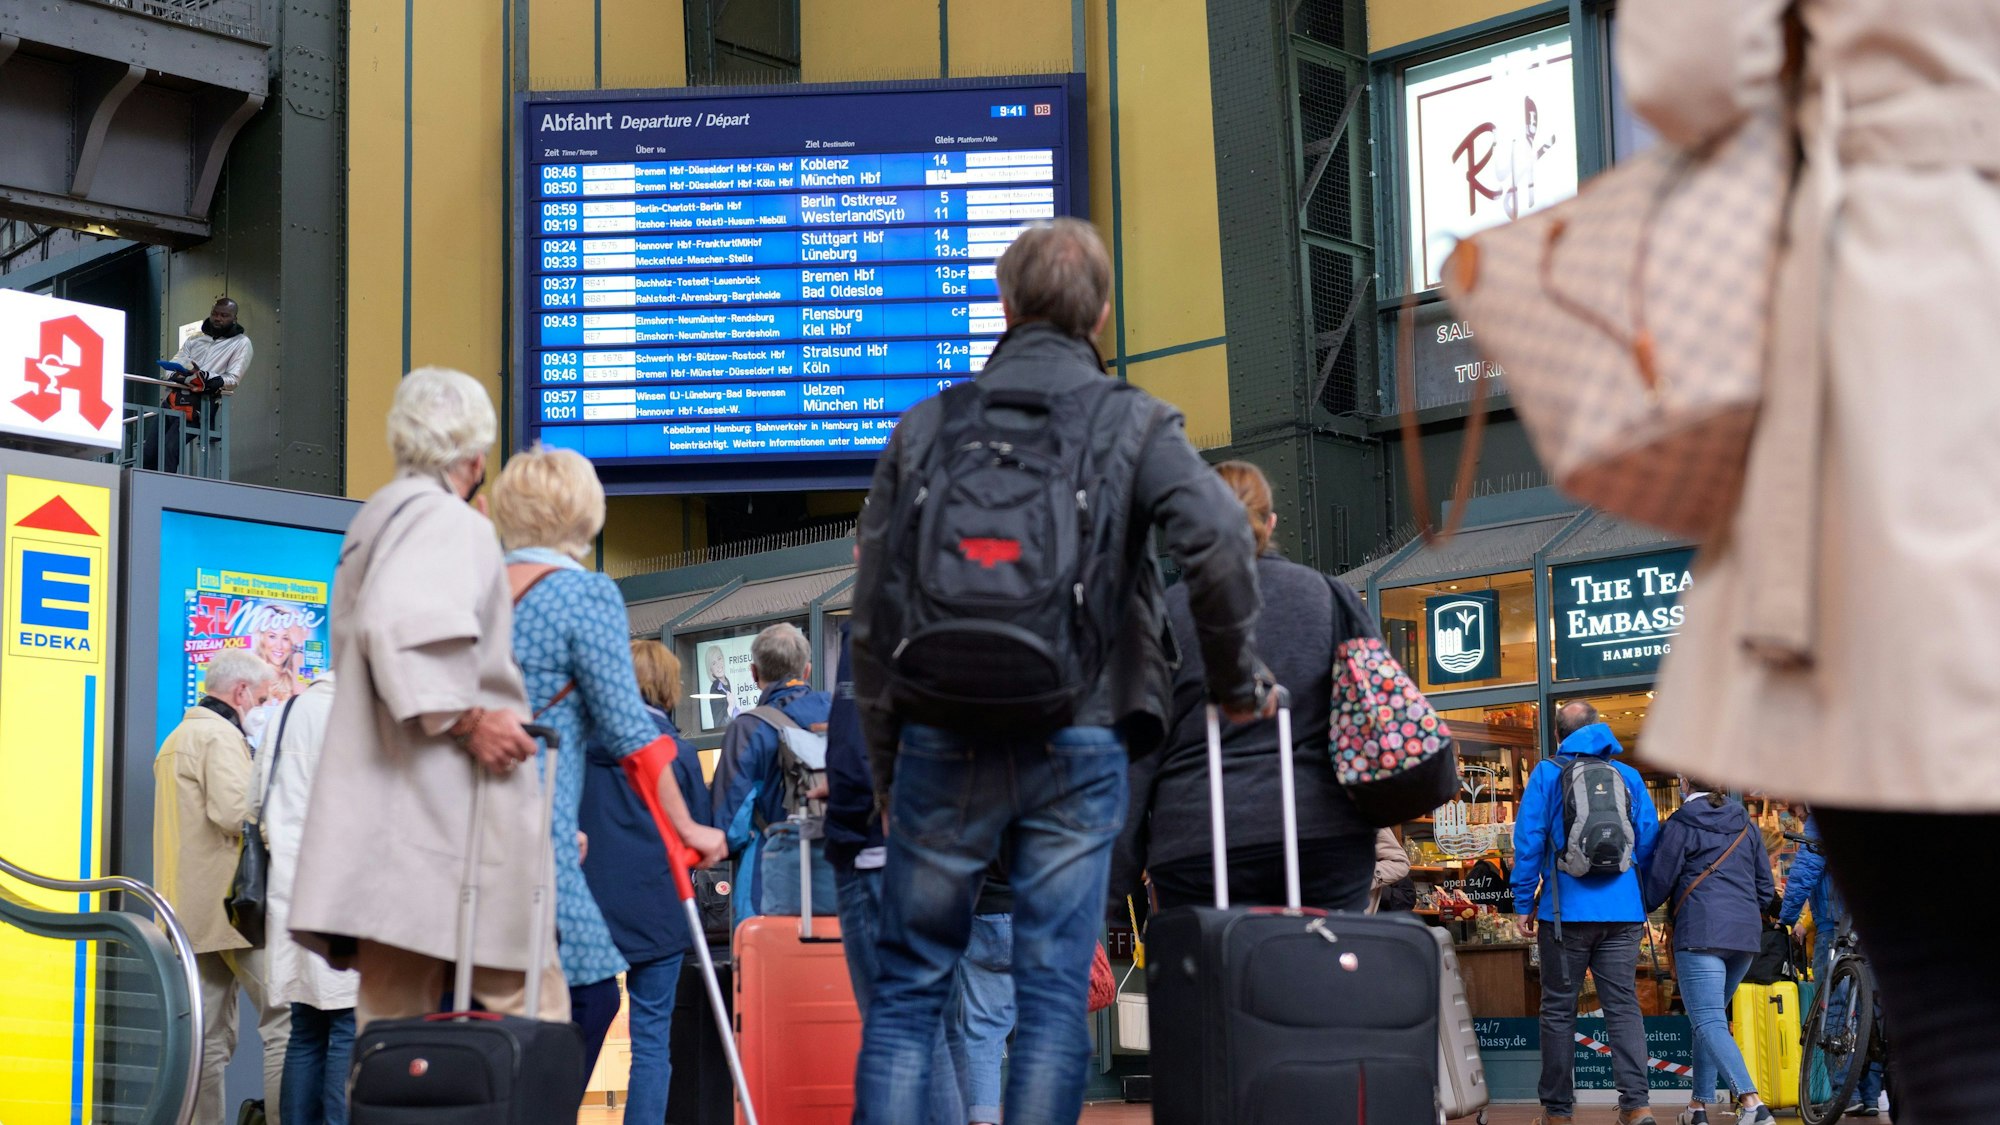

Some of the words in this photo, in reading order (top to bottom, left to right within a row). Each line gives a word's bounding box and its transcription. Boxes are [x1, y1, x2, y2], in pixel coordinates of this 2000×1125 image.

[1000, 106, 1022, 116] 9:41
[1036, 106, 1049, 114] DB
[541, 113, 613, 131] Abfahrt
[621, 115, 692, 130] Departure
[696, 114, 702, 126] /
[706, 113, 750, 128] Départ
[805, 140, 819, 148] Ziel
[935, 136, 954, 144] Gleis
[545, 148, 559, 157] Zeit
[636, 145, 654, 155] Über
[801, 158, 848, 171] Koblenz
[934, 154, 948, 166] 14
[544, 166, 576, 179] 08:46
[636, 166, 666, 176] Bremen
[737, 162, 775, 173] Hbf-Köln
[779, 162, 793, 171] Hbf
[935, 170, 948, 181] 14
[636, 182, 666, 191] Bremen
[737, 177, 775, 188] Hbf-Köln
[779, 177, 793, 187] Hbf
[801, 172, 855, 186] München
[860, 171, 880, 184] Hbf
[544, 182, 577, 194] 08:50
[802, 195, 835, 207] Berlin
[842, 194, 897, 206] Ostkreuz
[941, 192, 948, 203] 5
[544, 204, 577, 216] 08:59
[727, 200, 741, 210] Hbf
[802, 208, 904, 223] Westerland(Sylt)
[934, 208, 948, 219] 11
[544, 219, 577, 231] 09:19
[802, 232, 857, 246] Stuttgart
[864, 231, 884, 243] Hbf
[935, 230, 949, 241] 14
[544, 240, 576, 253] 09:24
[636, 240, 673, 251] Hannover
[802, 248, 857, 262] Lüneburg
[544, 256, 577, 268] 09:33
[802, 270, 849, 282] Bremen
[855, 269, 874, 281] Hbf
[544, 278, 576, 290] 09:37
[802, 286, 825, 298] Bad
[831, 285, 883, 297] Oldesloe
[544, 293, 576, 306] 09:41
[802, 307, 862, 322] Flensburg
[544, 315, 577, 328] 09:43
[802, 324, 825, 336] Kiel
[831, 323, 851, 335] Hbf
[636, 353, 674, 364] Schwerin
[771, 350, 785, 360] Hbf
[803, 346, 861, 358] Stralsund
[867, 344, 888, 357] Hbf
[544, 353, 577, 366] 09:43
[936, 359, 951, 370] 14
[636, 369, 667, 379] Bremen
[778, 365, 792, 375] Hbf
[803, 361, 830, 374] Köln
[544, 368, 577, 381] 09:46
[636, 391, 666, 401] Winsen
[746, 388, 786, 398] Bevensen
[803, 383, 844, 396] Uelzen
[544, 390, 577, 403] 09:57
[804, 398, 858, 412] München
[864, 398, 884, 410] Hbf
[545, 406, 577, 419] 10:01
[636, 407, 674, 417] Hannover
[663, 424, 710, 435] Kabelbrand
[714, 423, 752, 435] Hamburg:
[756, 421, 807, 432] Bahnverkehr
[811, 422, 818, 430] in
[822, 420, 858, 432] Hamburg
[862, 420, 873, 429] ist
[670, 440, 729, 451] beeinträchtigt.
[733, 438, 765, 448] Weitere
[769, 435, 825, 447] Informationen
[829, 437, 850, 446] unter
[1570, 576, 1632, 604] THE
[1637, 566, 1694, 596] TEA
[224, 600, 326, 636] Movie
[1567, 605, 1688, 638] EMBASS
[20, 632, 91, 652] EDEKA
[1603, 644, 1671, 661] HAMBURG
[738, 696, 751, 706] Tel.
[1443, 879, 1466, 890] open
[1470, 876, 1492, 888] 24/7
[1474, 1020, 1500, 1034] 24/7
